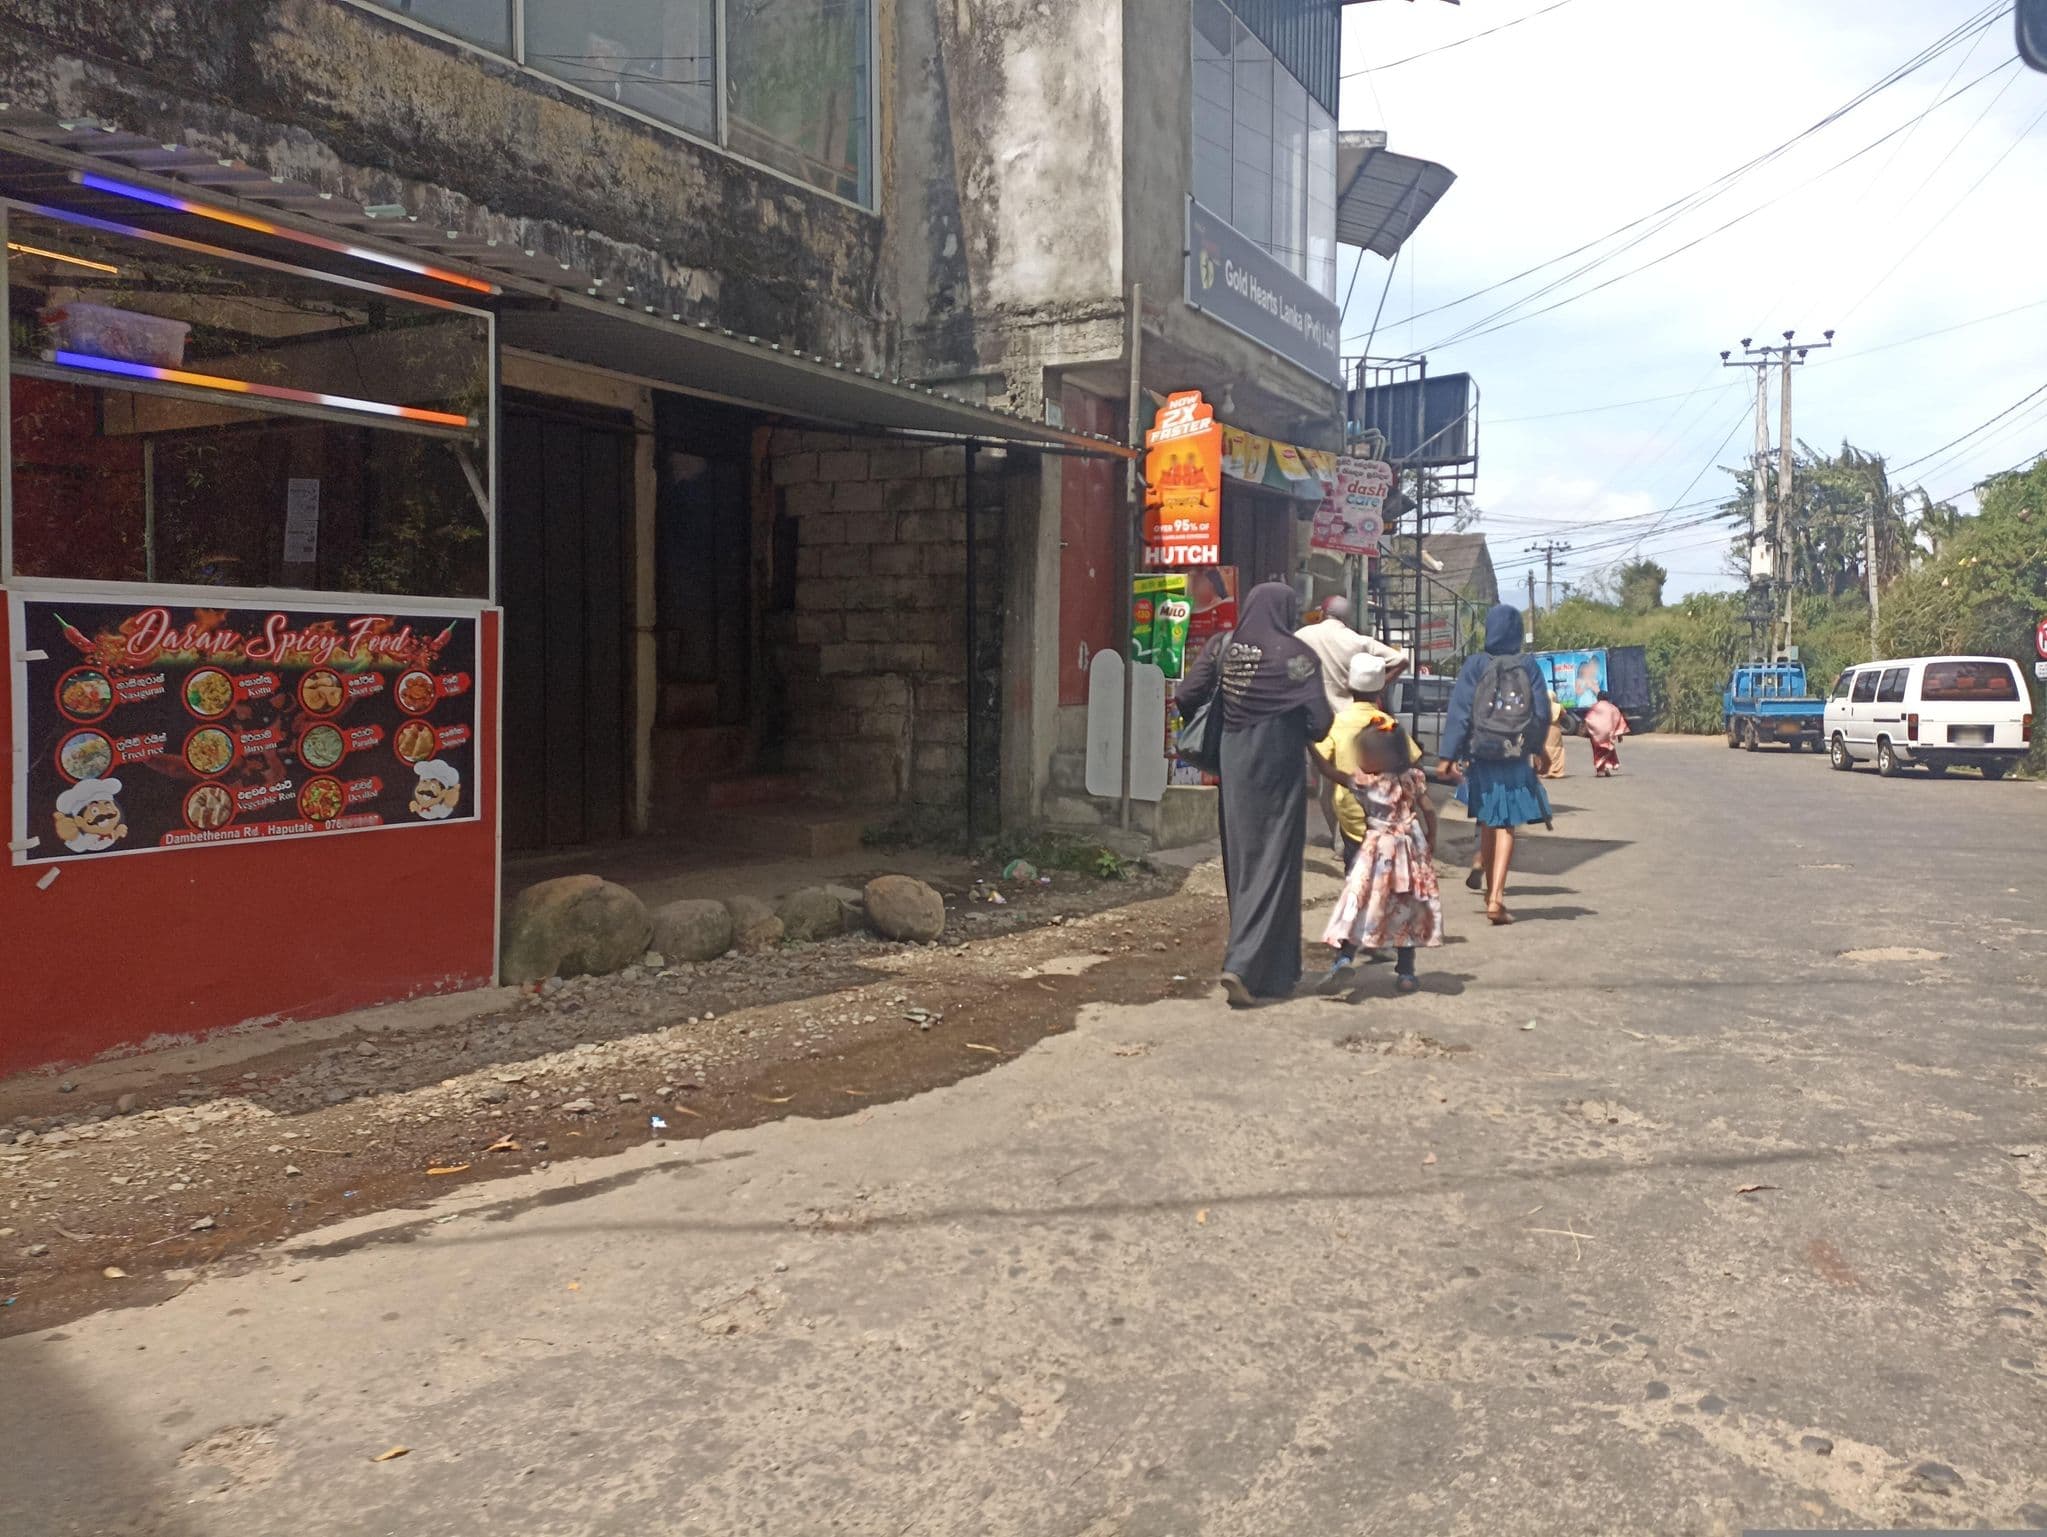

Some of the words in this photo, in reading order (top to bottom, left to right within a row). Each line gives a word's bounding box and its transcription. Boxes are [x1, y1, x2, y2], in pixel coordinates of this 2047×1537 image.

[1225, 258, 1248, 297] Gold
[1249, 274, 1278, 316] Hearts
[1279, 295, 1303, 332] Lanka
[1161, 404, 1198, 428] 2X
[1151, 418, 1212, 443] FASTER
[1347, 480, 1387, 497] dash
[1346, 494, 1380, 508] care
[1173, 518, 1198, 532] 95%
[1145, 545, 1218, 564] HUTCH
[1160, 606, 1186, 618] MILO
[246, 614, 343, 663] Spicy
[348, 616, 410, 658] Food
[122, 749, 146, 760] Fried
[147, 747, 165, 756] rice
[237, 797, 277, 810] Vegetable
[278, 792, 296, 801] Roti
[243, 826, 259, 837] Rd
[267, 822, 314, 836] Haputale
